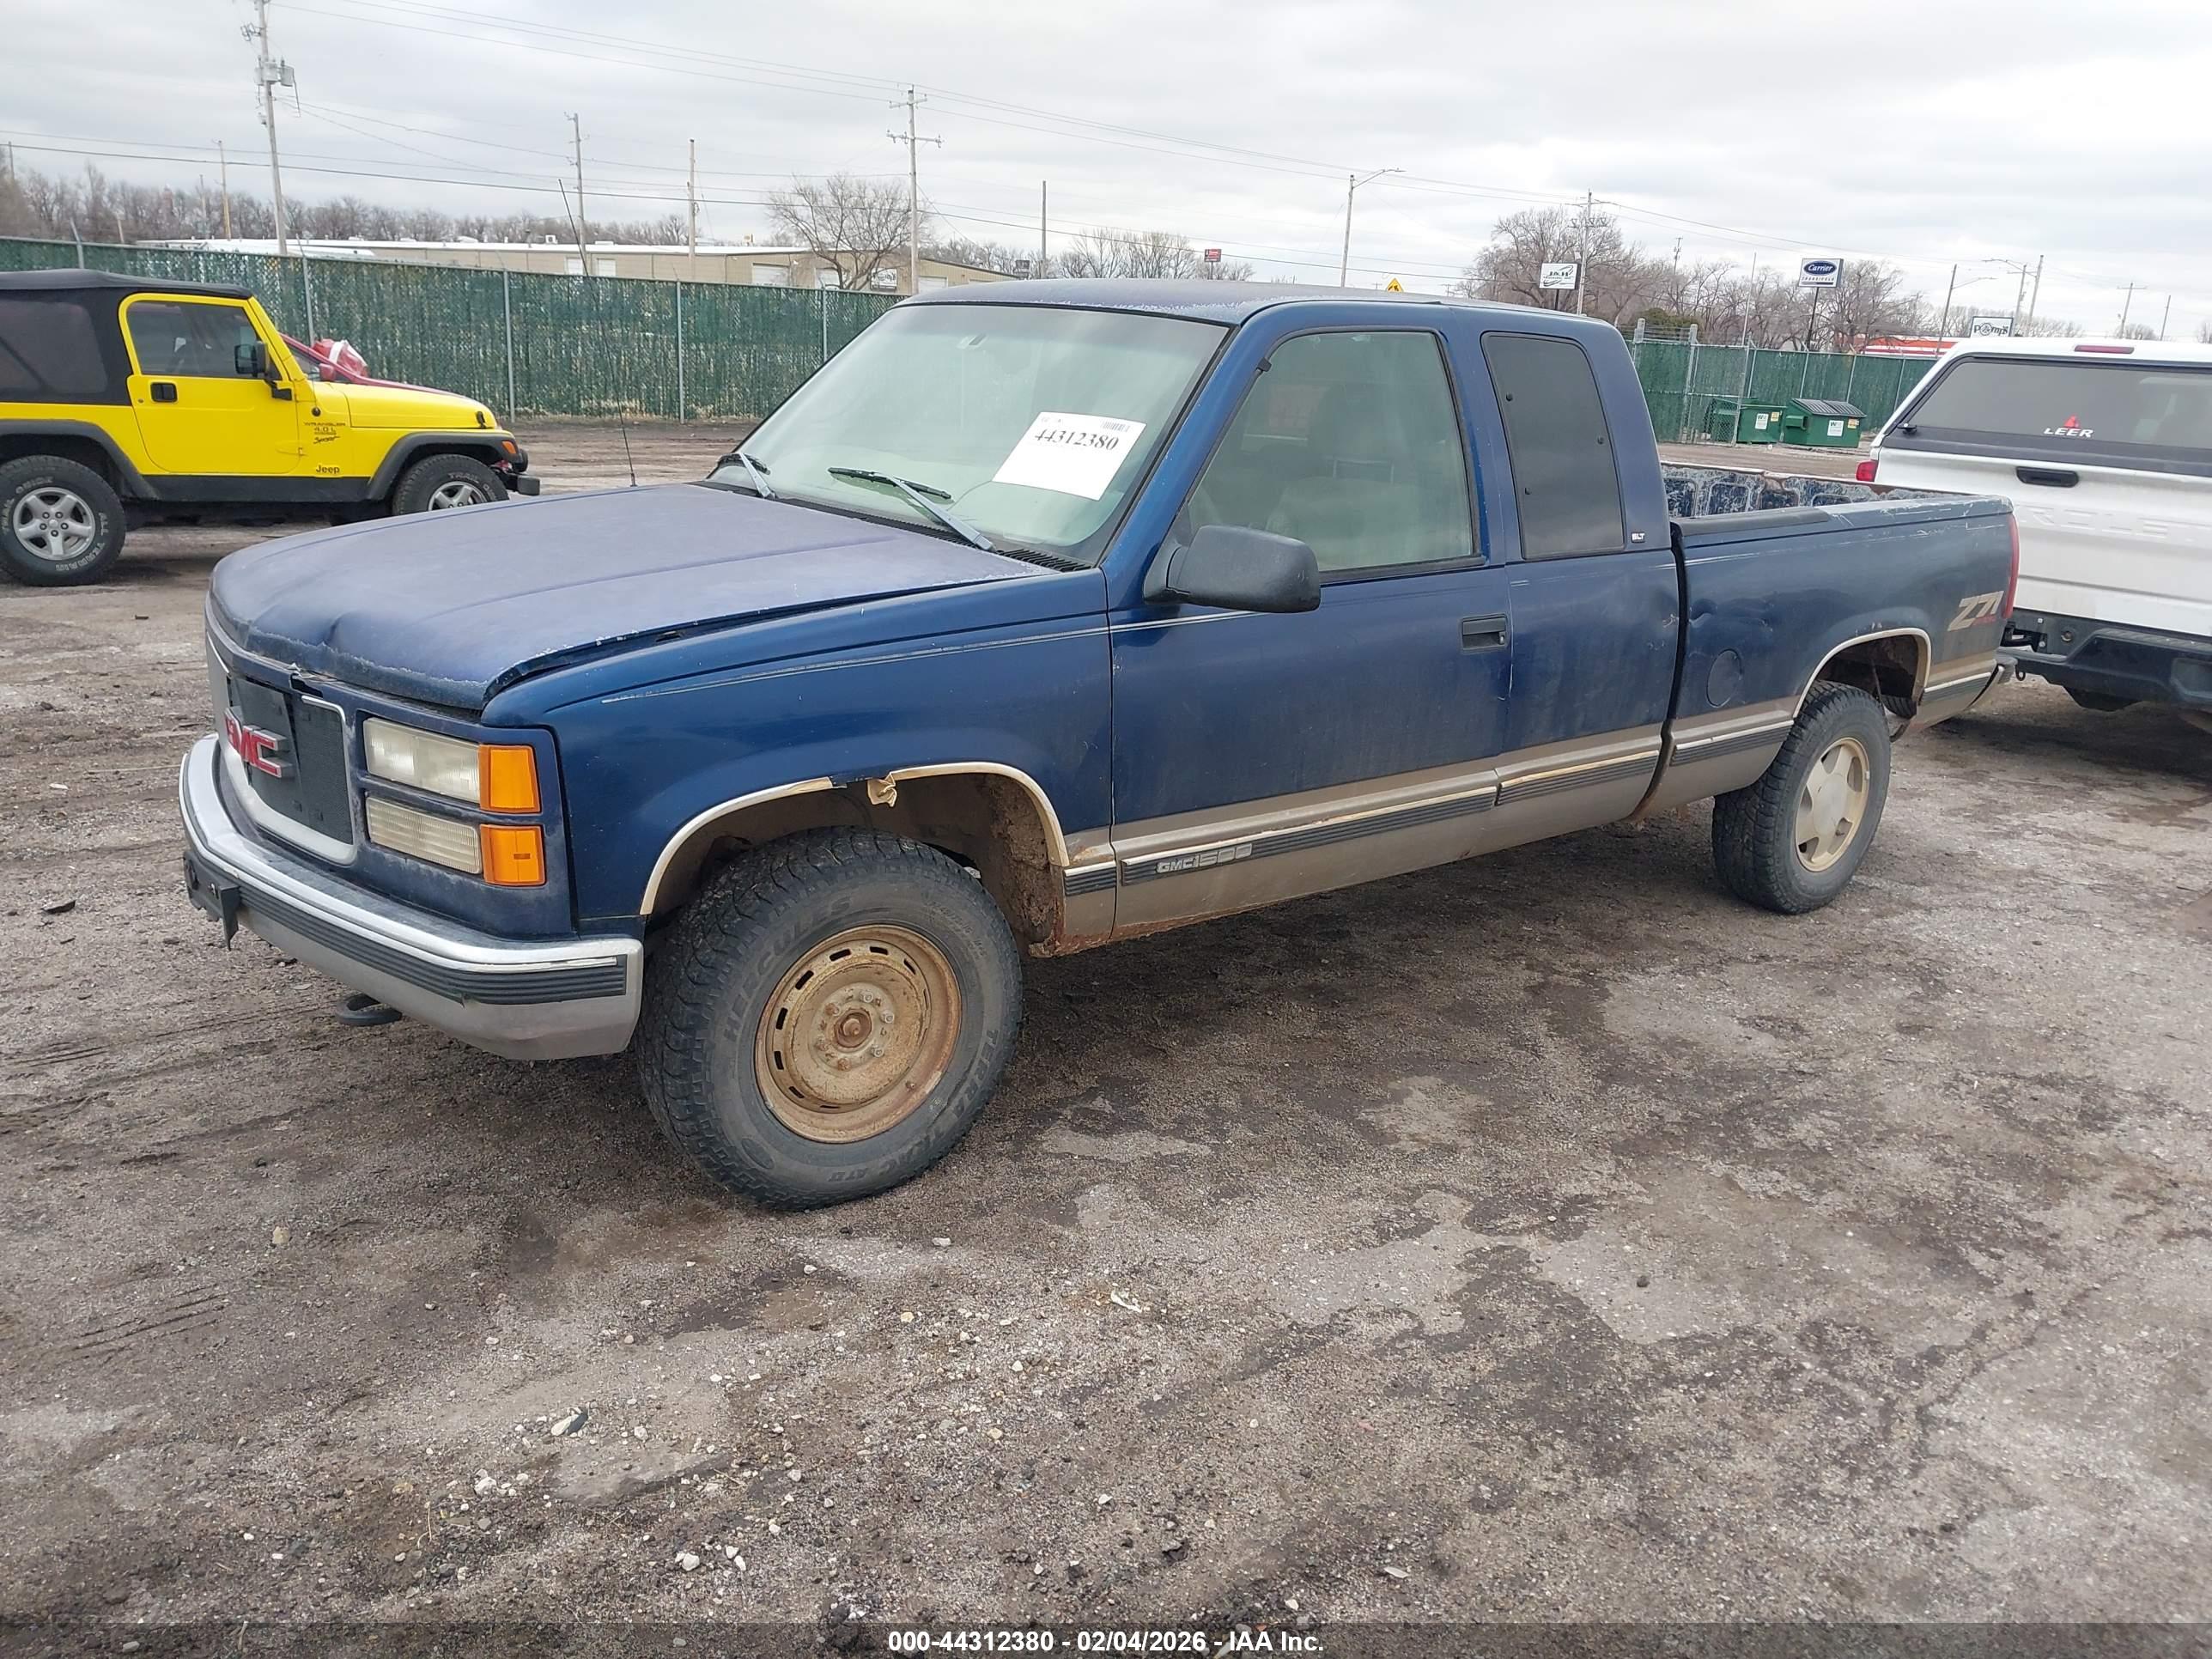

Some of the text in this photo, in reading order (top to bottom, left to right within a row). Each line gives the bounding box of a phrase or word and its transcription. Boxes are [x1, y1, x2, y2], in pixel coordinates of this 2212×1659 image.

[1808, 264, 1833, 272] Carrier
[1034, 429, 1120, 452] 44312380
[2043, 427, 2094, 438] LEER
[315, 464, 341, 474] Jeep
[1947, 590, 2005, 632] Z71
[223, 707, 283, 779] GMC
